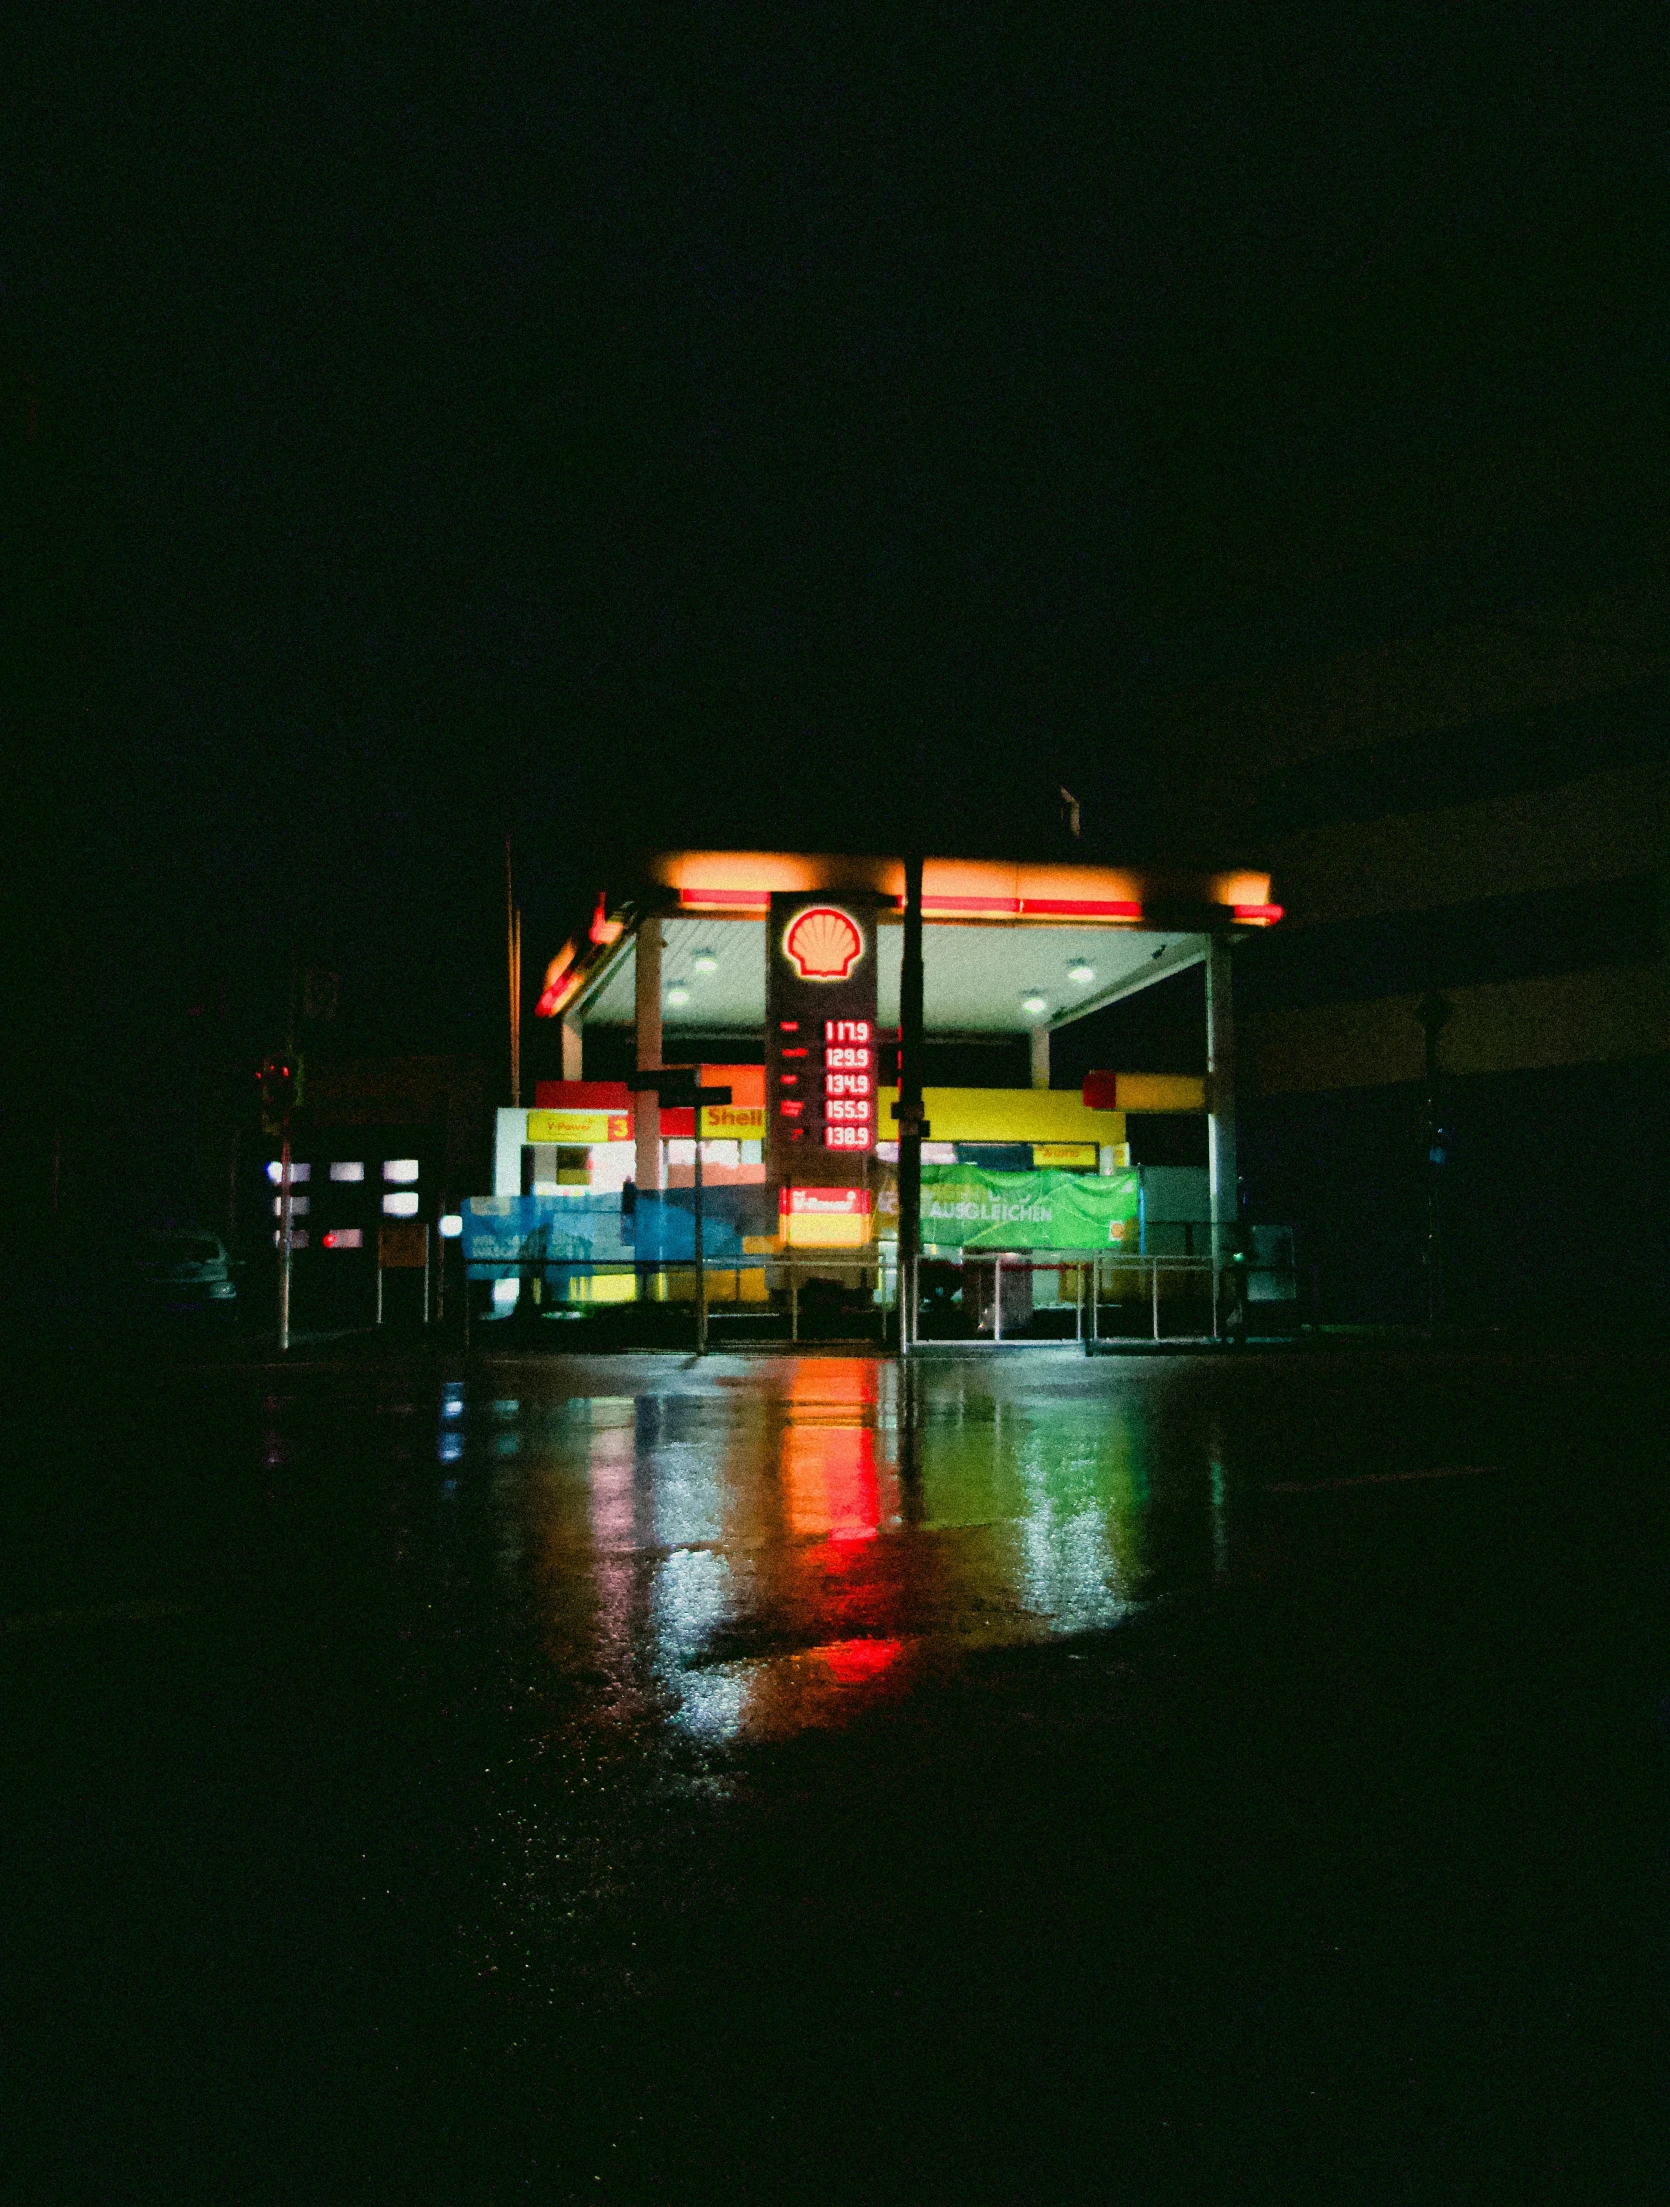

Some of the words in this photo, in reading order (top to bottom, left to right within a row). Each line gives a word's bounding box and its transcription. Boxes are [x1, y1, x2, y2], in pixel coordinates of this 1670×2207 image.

[826, 1021, 868, 1041] 117.9
[826, 1048, 868, 1067] 129.9
[826, 1074, 868, 1094] 134.9
[708, 1107, 763, 1126] Shell
[826, 1100, 868, 1119] 155.9
[614, 1119, 629, 1137] 3
[826, 1127, 868, 1145] 138.9
[929, 1202, 1052, 1222] AUSGLEICHEN
